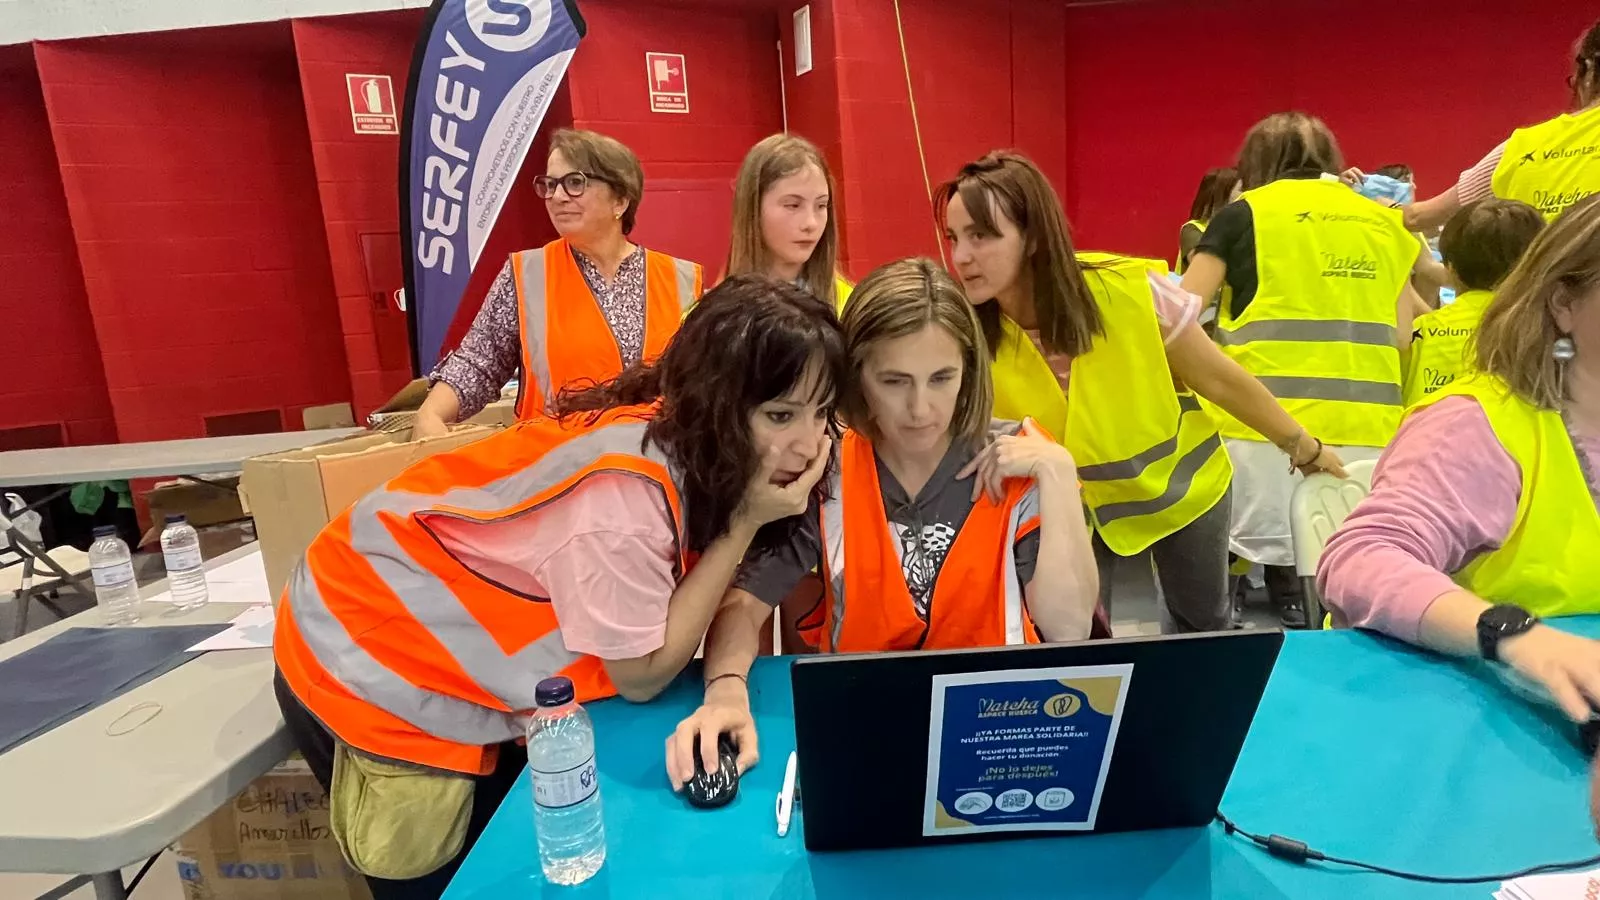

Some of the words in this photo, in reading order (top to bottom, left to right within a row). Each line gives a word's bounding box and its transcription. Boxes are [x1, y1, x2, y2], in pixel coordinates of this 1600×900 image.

[475, 138, 509, 206] COMPROMETIDOS
[505, 120, 519, 139] CON
[513, 84, 534, 122] NUESTRO
[418, 30, 485, 275] SERFEY
[477, 192, 498, 229] ENTORNO
[497, 171, 507, 189] LAS
[505, 131, 525, 173] PERSONAS
[521, 115, 533, 132] QUE
[528, 92, 544, 116] VIVEN
[994, 727, 1032, 735] FORMAS
[1034, 725, 1062, 733] PARTE
[960, 736, 1001, 744] NUESTRA
[1003, 733, 1034, 741] MAREA
[976, 747, 1017, 755] Recuerda
[1008, 765, 1020, 773] lo
[1022, 764, 1053, 773] dejes
[978, 773, 1005, 783] para
